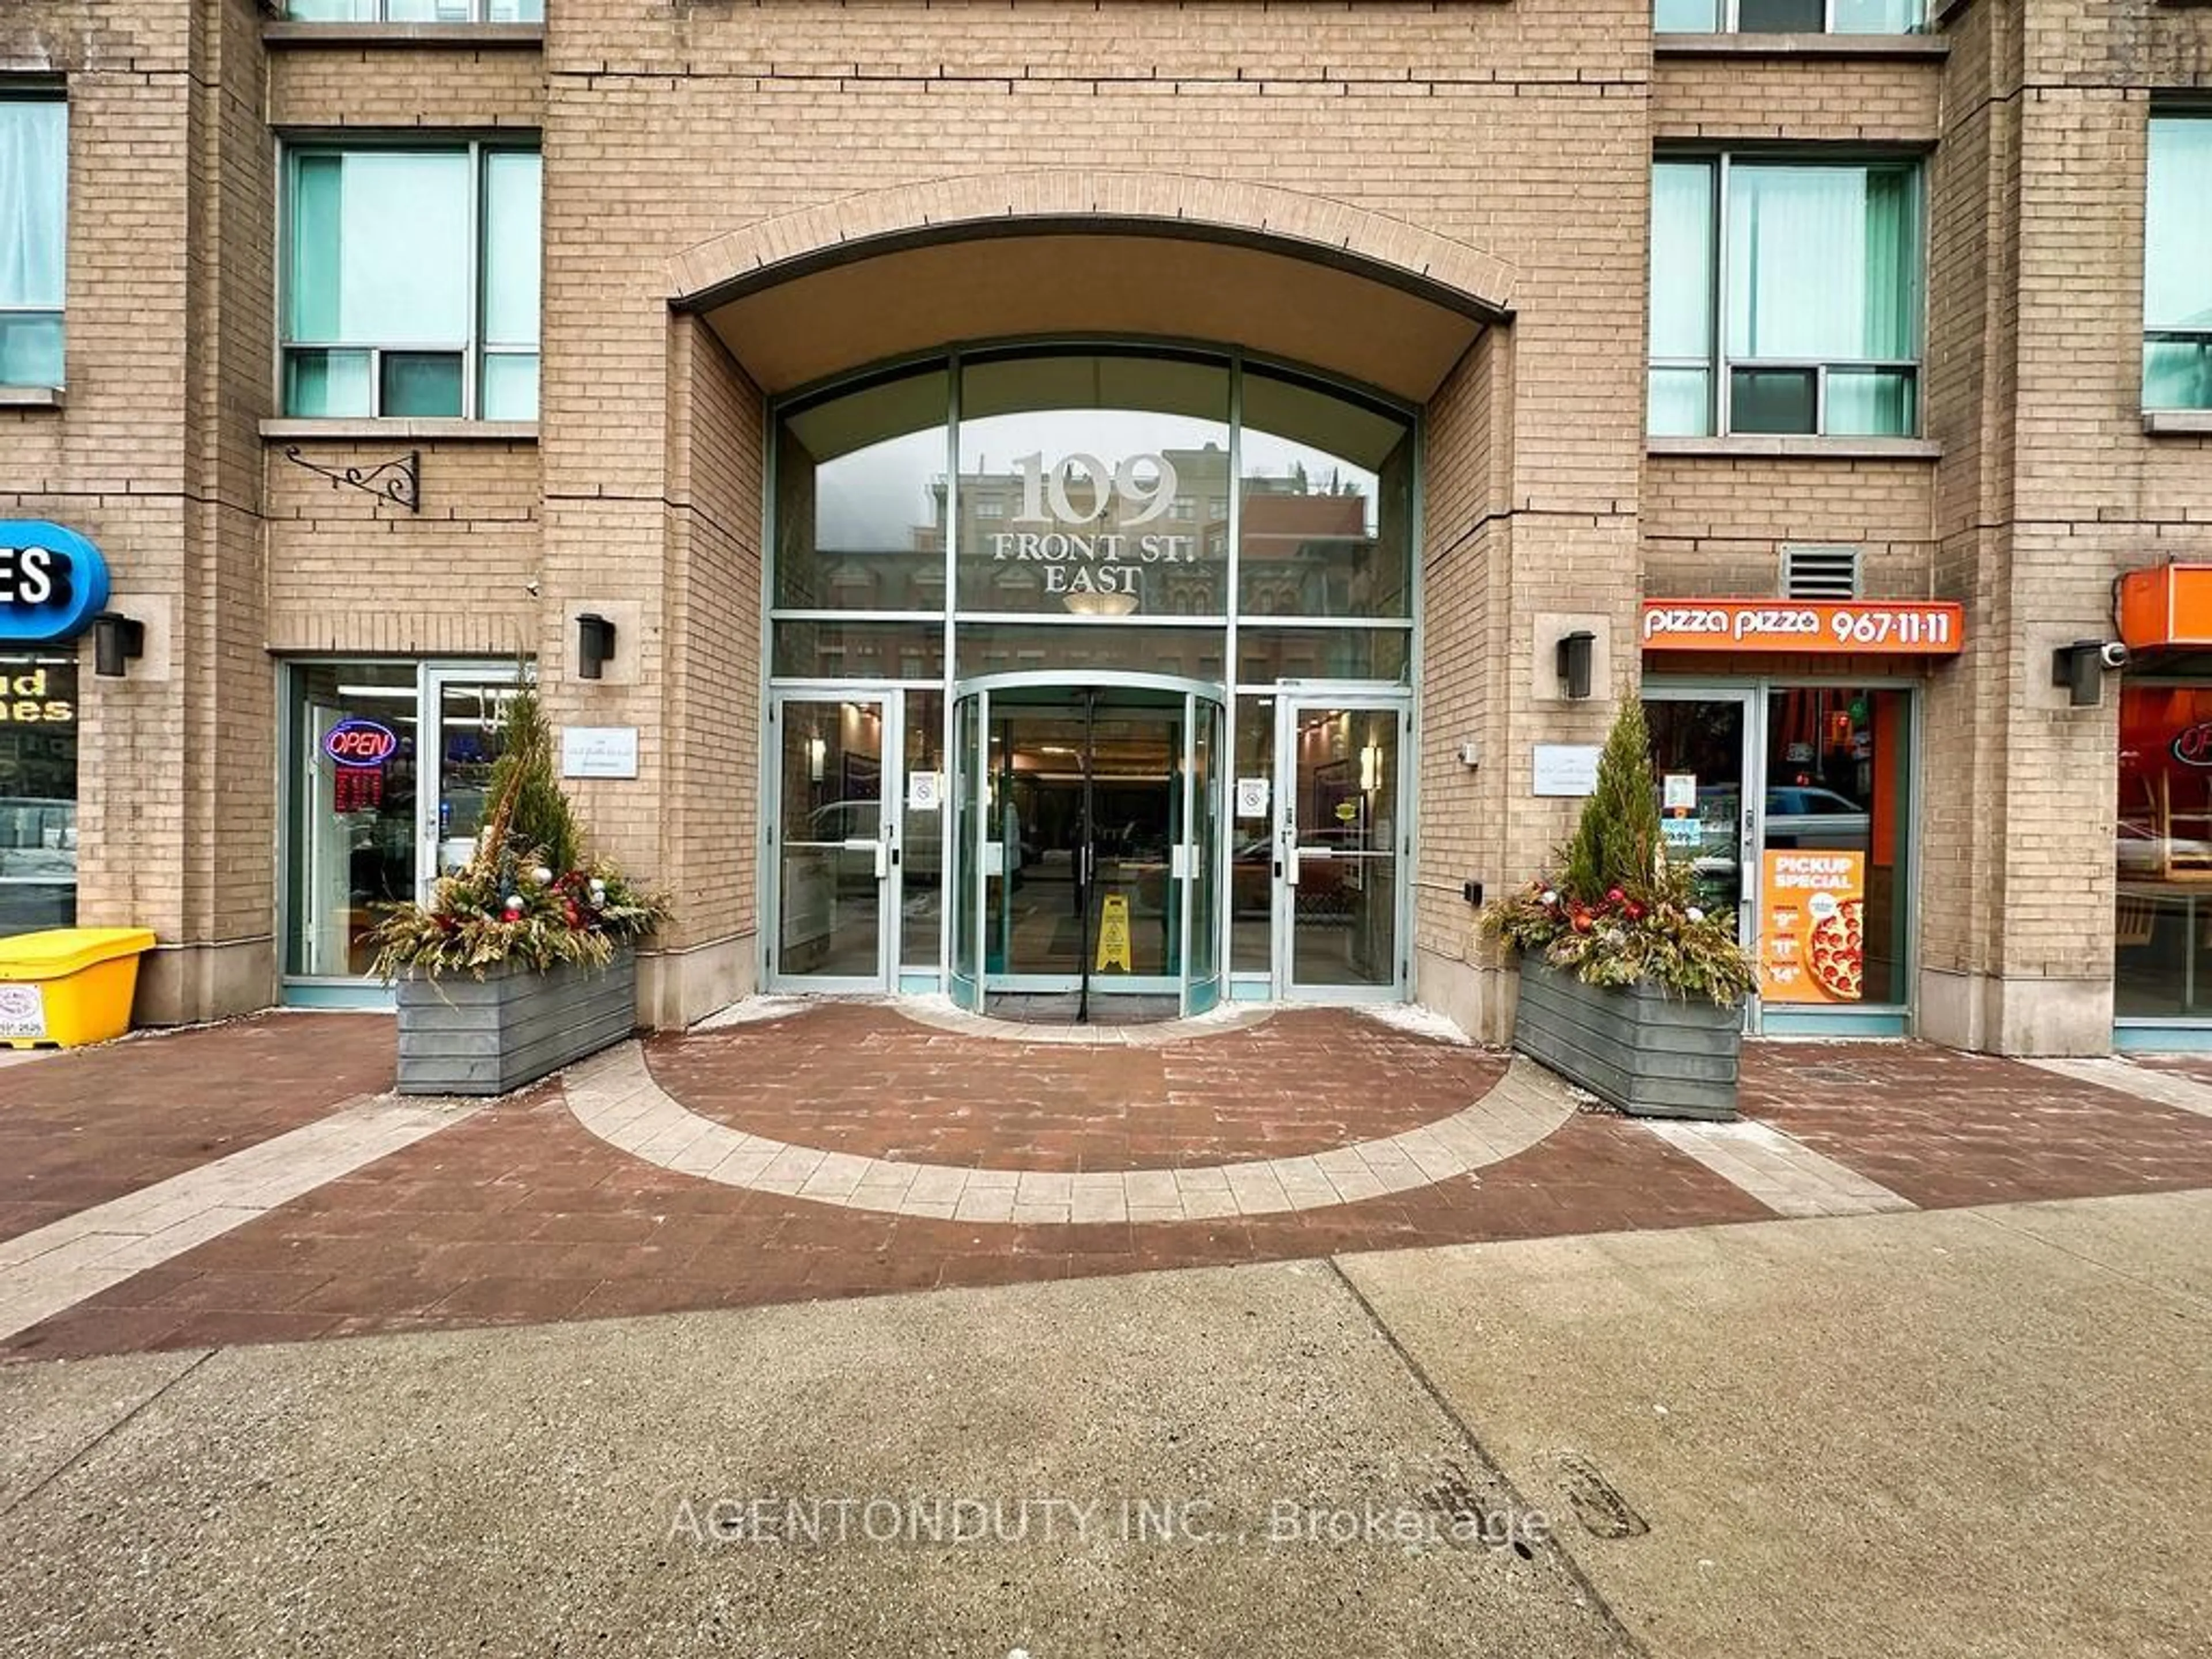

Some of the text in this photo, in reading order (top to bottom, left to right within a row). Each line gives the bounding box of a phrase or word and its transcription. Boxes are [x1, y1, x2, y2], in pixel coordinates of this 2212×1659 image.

[1012, 450, 1177, 525] 109
[987, 532, 1195, 563] FRONT ST.
[1044, 565, 1142, 594] EAST
[330, 732, 389, 755] OPEN
[1775, 857, 1854, 873] PICKUP
[1774, 874, 1853, 888] SPECIAL
